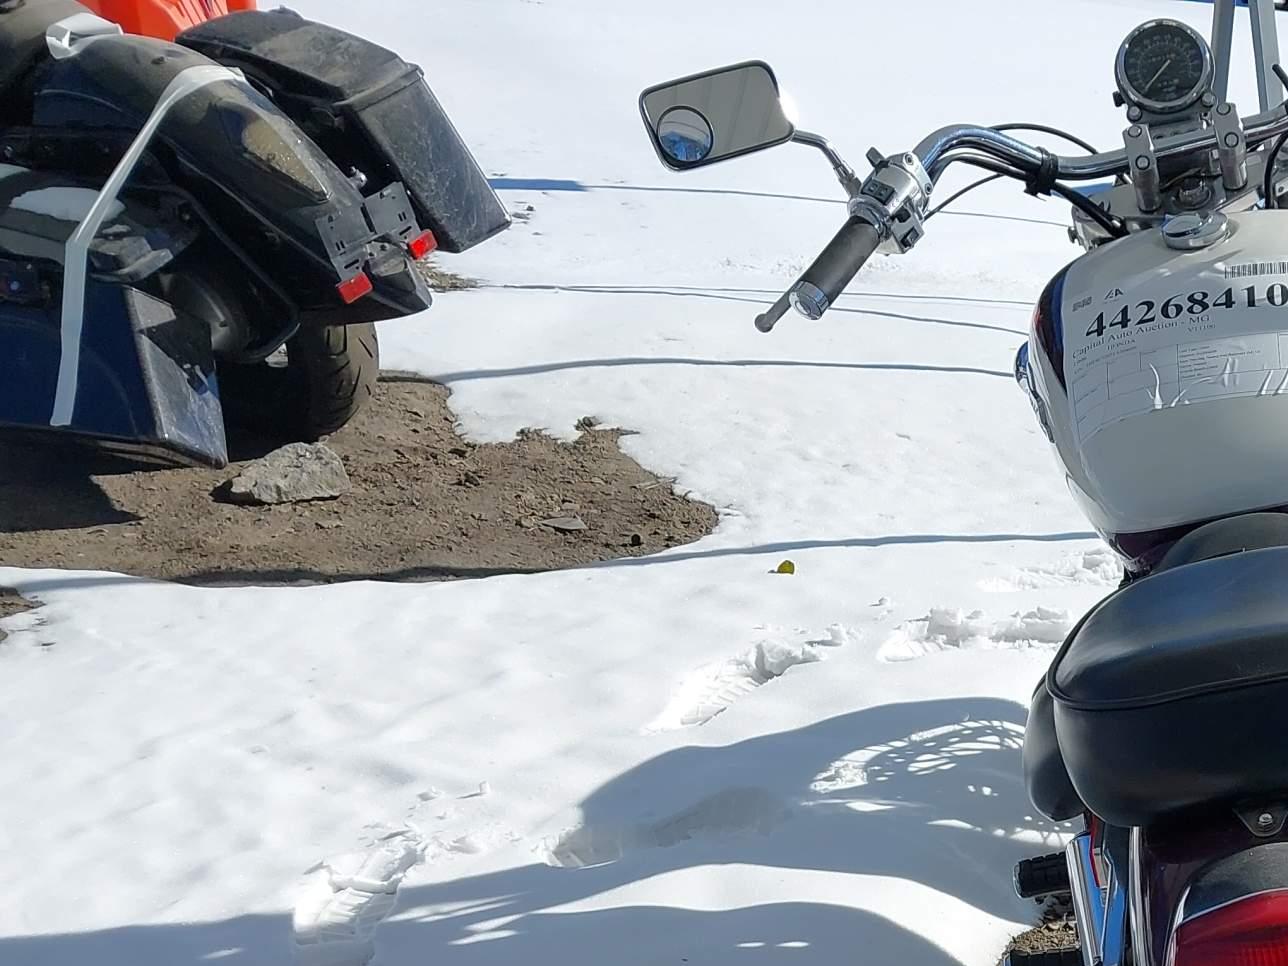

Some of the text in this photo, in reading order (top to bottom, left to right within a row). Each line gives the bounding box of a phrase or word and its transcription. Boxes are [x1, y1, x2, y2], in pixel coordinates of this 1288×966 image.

[1072, 336, 1105, 359] Capital
[1106, 330, 1133, 345] Auto
[1135, 320, 1178, 335] Auction
